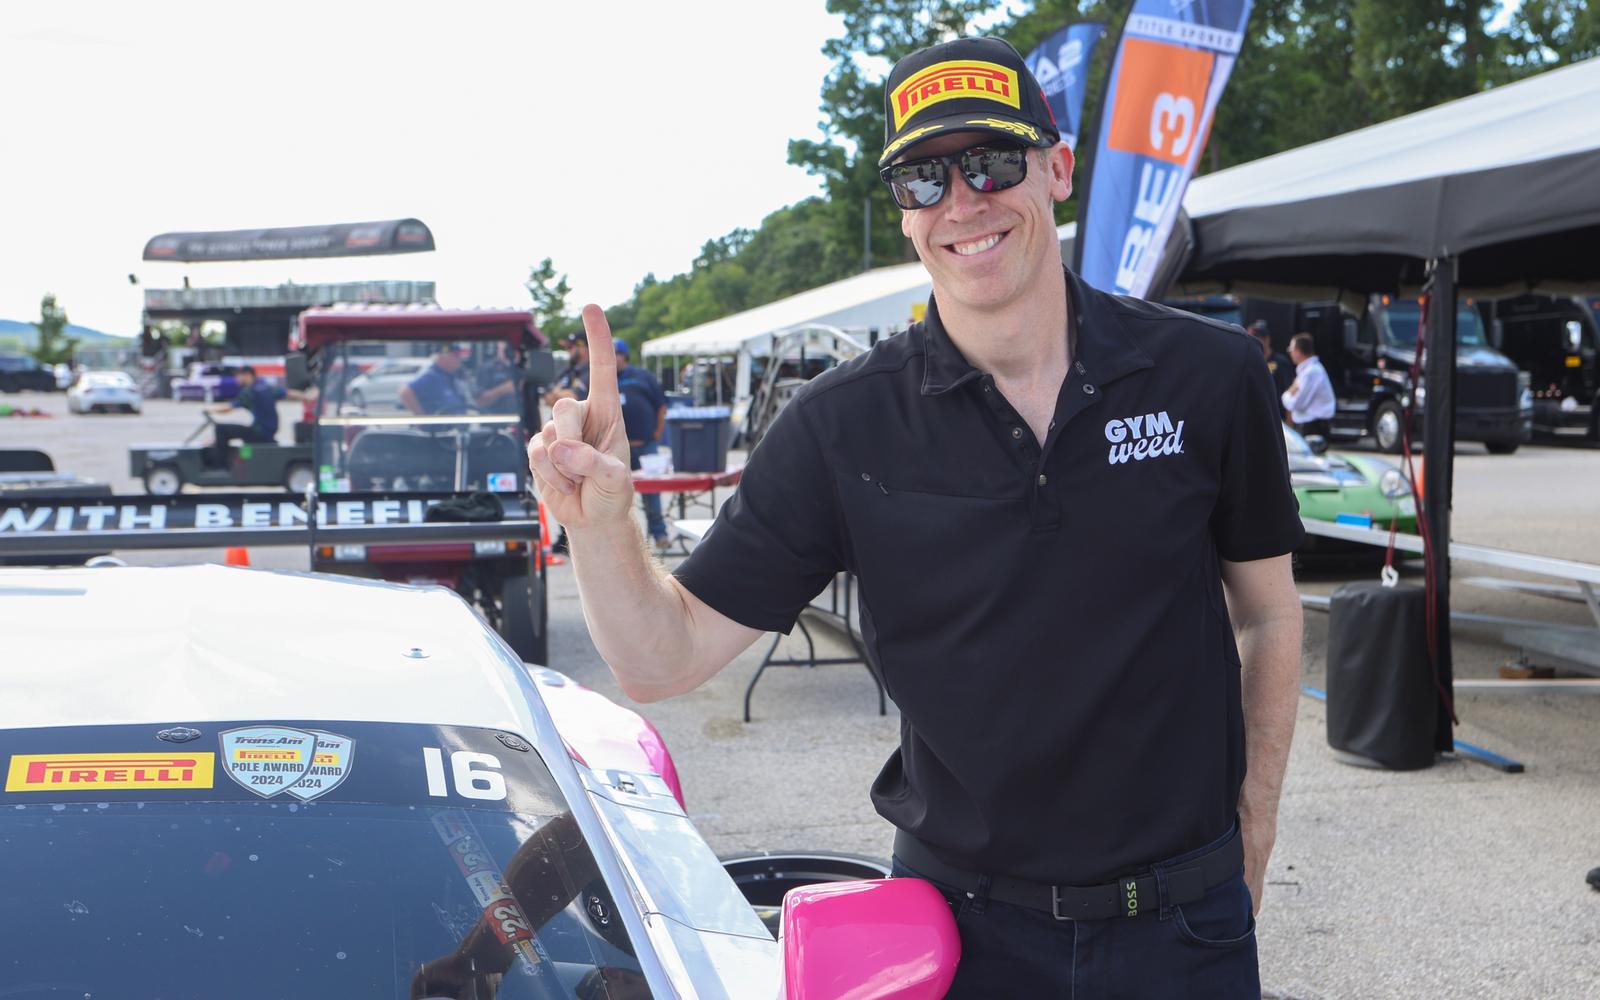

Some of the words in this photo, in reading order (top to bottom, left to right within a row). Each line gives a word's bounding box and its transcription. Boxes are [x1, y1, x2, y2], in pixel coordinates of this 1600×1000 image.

[1137, 19, 1173, 34] TITLE
[1033, 39, 1082, 84] A2
[897, 66, 1010, 118] PIRELLI
[1113, 162, 1180, 295] BE
[1105, 411, 1174, 443] GYM
[1108, 420, 1184, 465] weed
[0, 504, 167, 532] WITH
[194, 500, 441, 528] BENEFI
[234, 736, 275, 744] Trans
[276, 736, 304, 745] Am
[240, 750, 295, 759] PIRELLI
[26, 759, 197, 784] PIRELLI
[232, 762, 259, 772] POLE
[263, 762, 304, 773] AWARD
[251, 775, 284, 785] 2024
[310, 766, 342, 776] WARD
[423, 747, 507, 801] 16
[1126, 881, 1138, 917] BOSS
